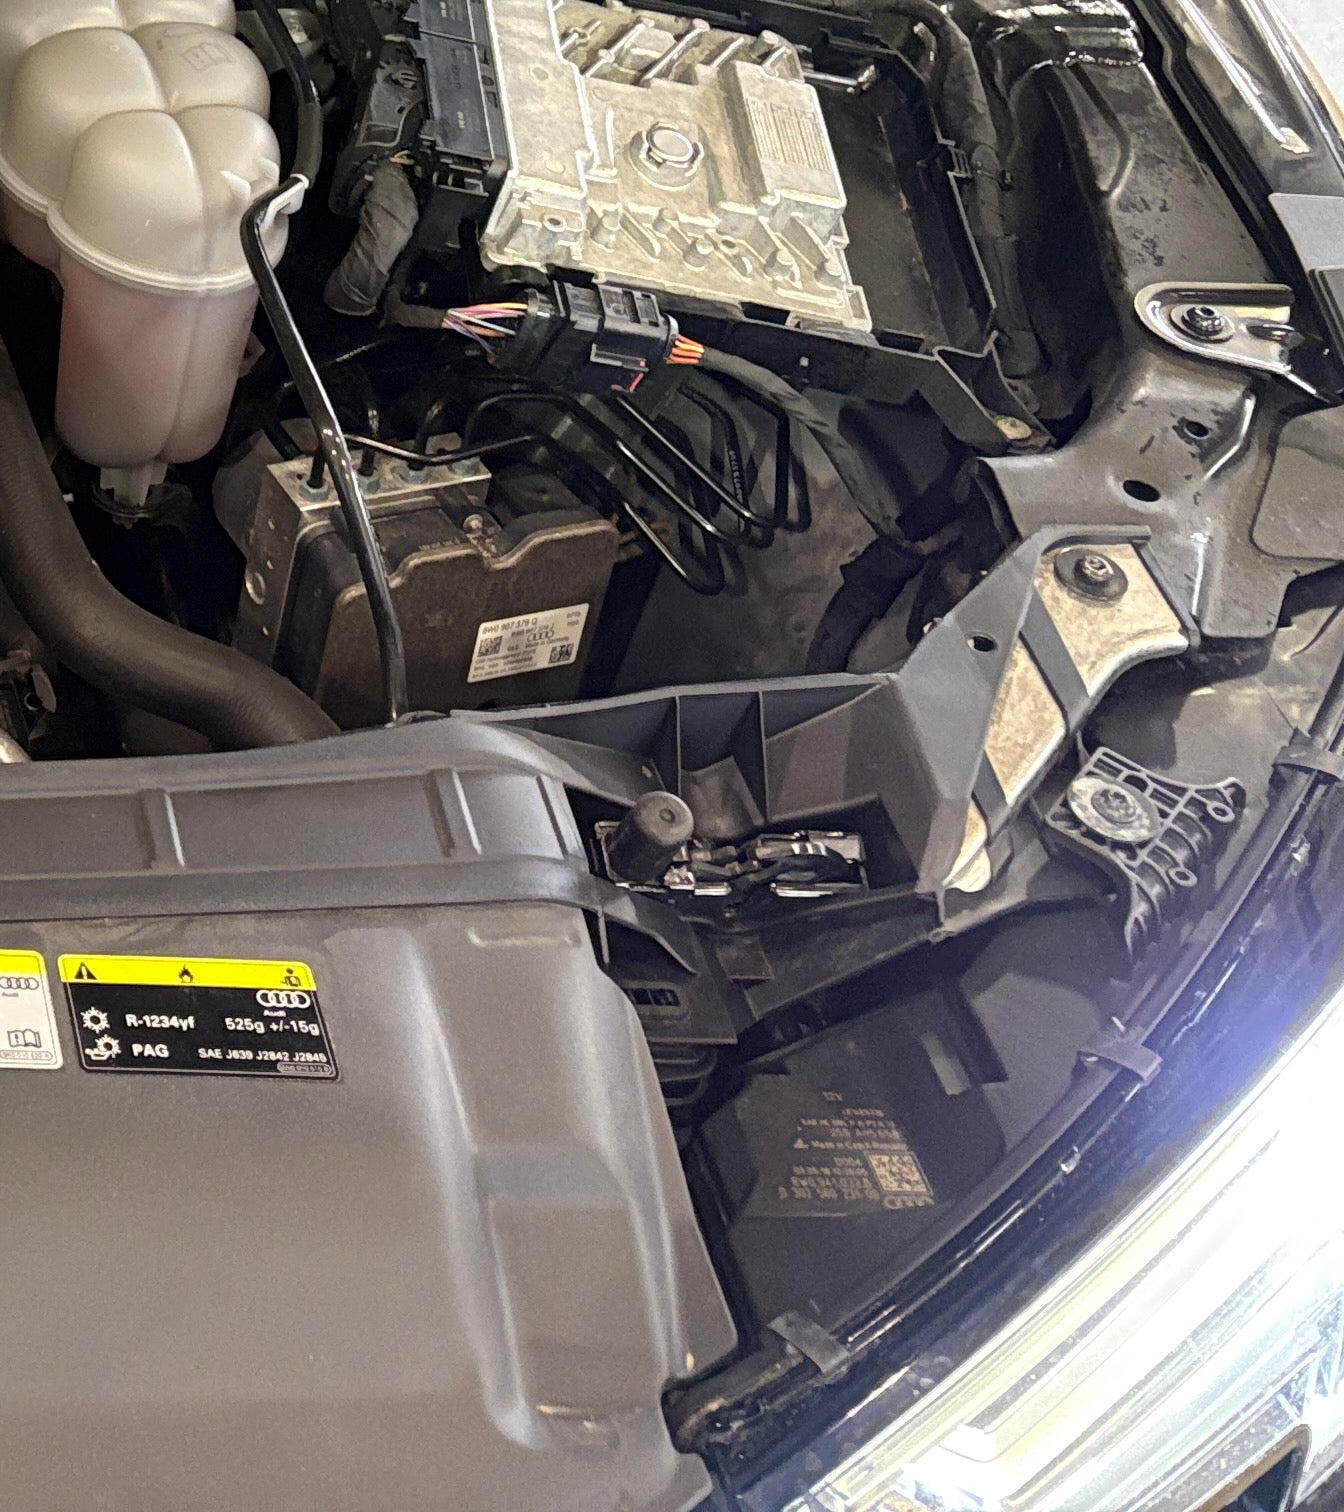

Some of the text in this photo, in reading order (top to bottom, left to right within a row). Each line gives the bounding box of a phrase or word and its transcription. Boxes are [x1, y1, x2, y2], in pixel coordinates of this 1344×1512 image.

[125, 1014, 197, 1031] R-1234yf
[225, 1019, 320, 1036] 525g +/-15g
[132, 1045, 170, 1058] PAG
[198, 1049, 223, 1059] SAE
[226, 1050, 254, 1061] J639
[256, 1052, 291, 1062] J2842
